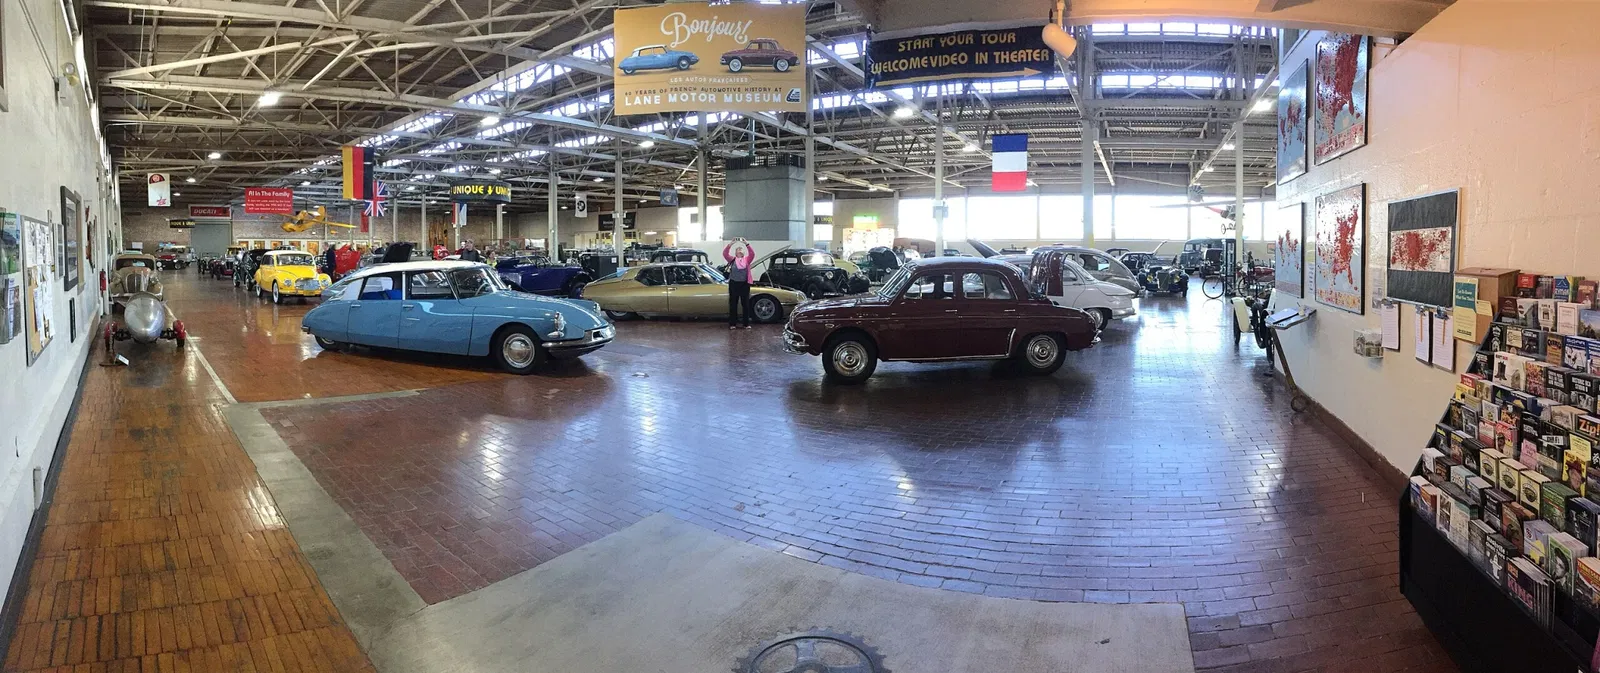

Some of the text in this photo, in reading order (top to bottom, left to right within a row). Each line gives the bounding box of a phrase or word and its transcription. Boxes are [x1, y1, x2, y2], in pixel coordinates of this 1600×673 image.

[660, 12, 753, 48] Bonjour!
[898, 32, 1016, 52] START YOUR TOUR
[871, 49, 1049, 74] WELCOME VIDEO IN THEATER
[625, 95, 661, 106] LANE
[668, 92, 716, 103] MOTOR
[723, 93, 781, 103] MUSEUM
[452, 185, 484, 195] UNIQUE
[1579, 419, 1600, 437] Zip!
[1507, 575, 1533, 609] KING
